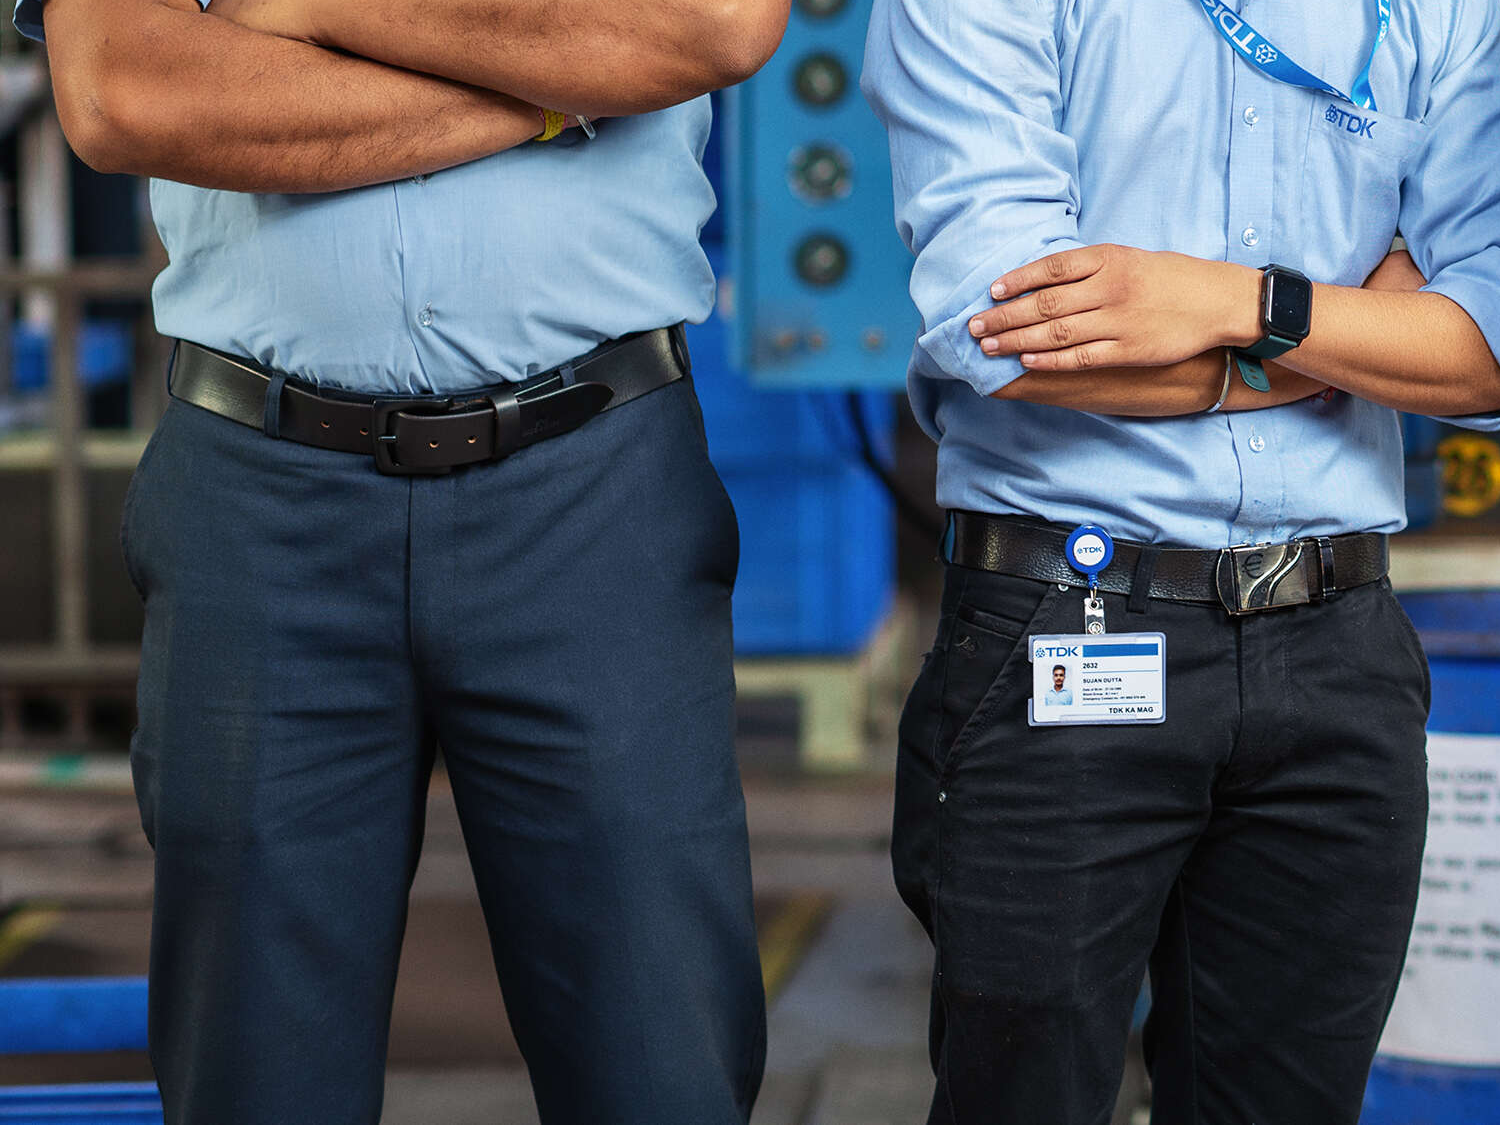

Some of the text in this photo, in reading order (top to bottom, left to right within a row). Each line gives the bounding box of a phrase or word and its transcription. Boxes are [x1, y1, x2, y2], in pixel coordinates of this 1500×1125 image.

[1336, 108, 1377, 139] TDK
[1083, 546, 1102, 554] TDK
[1045, 646, 1079, 657] TDK
